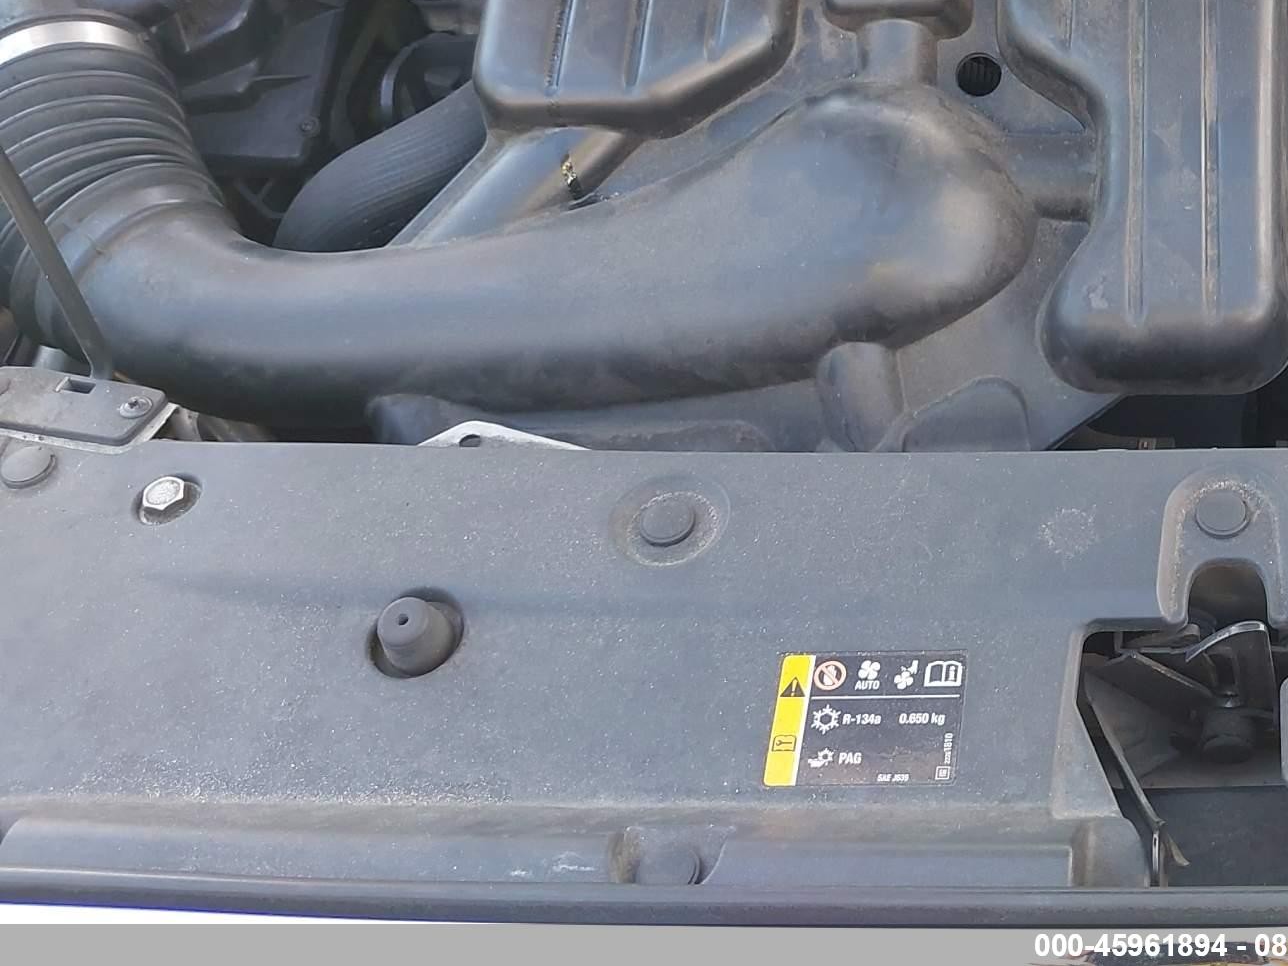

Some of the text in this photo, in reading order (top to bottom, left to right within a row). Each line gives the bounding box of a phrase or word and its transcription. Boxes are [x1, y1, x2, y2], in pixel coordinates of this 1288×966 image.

[855, 680, 880, 690] AUTO
[842, 713, 881, 725] R-134a
[899, 713, 945, 726] 0.650 kg
[838, 751, 862, 765] PAG
